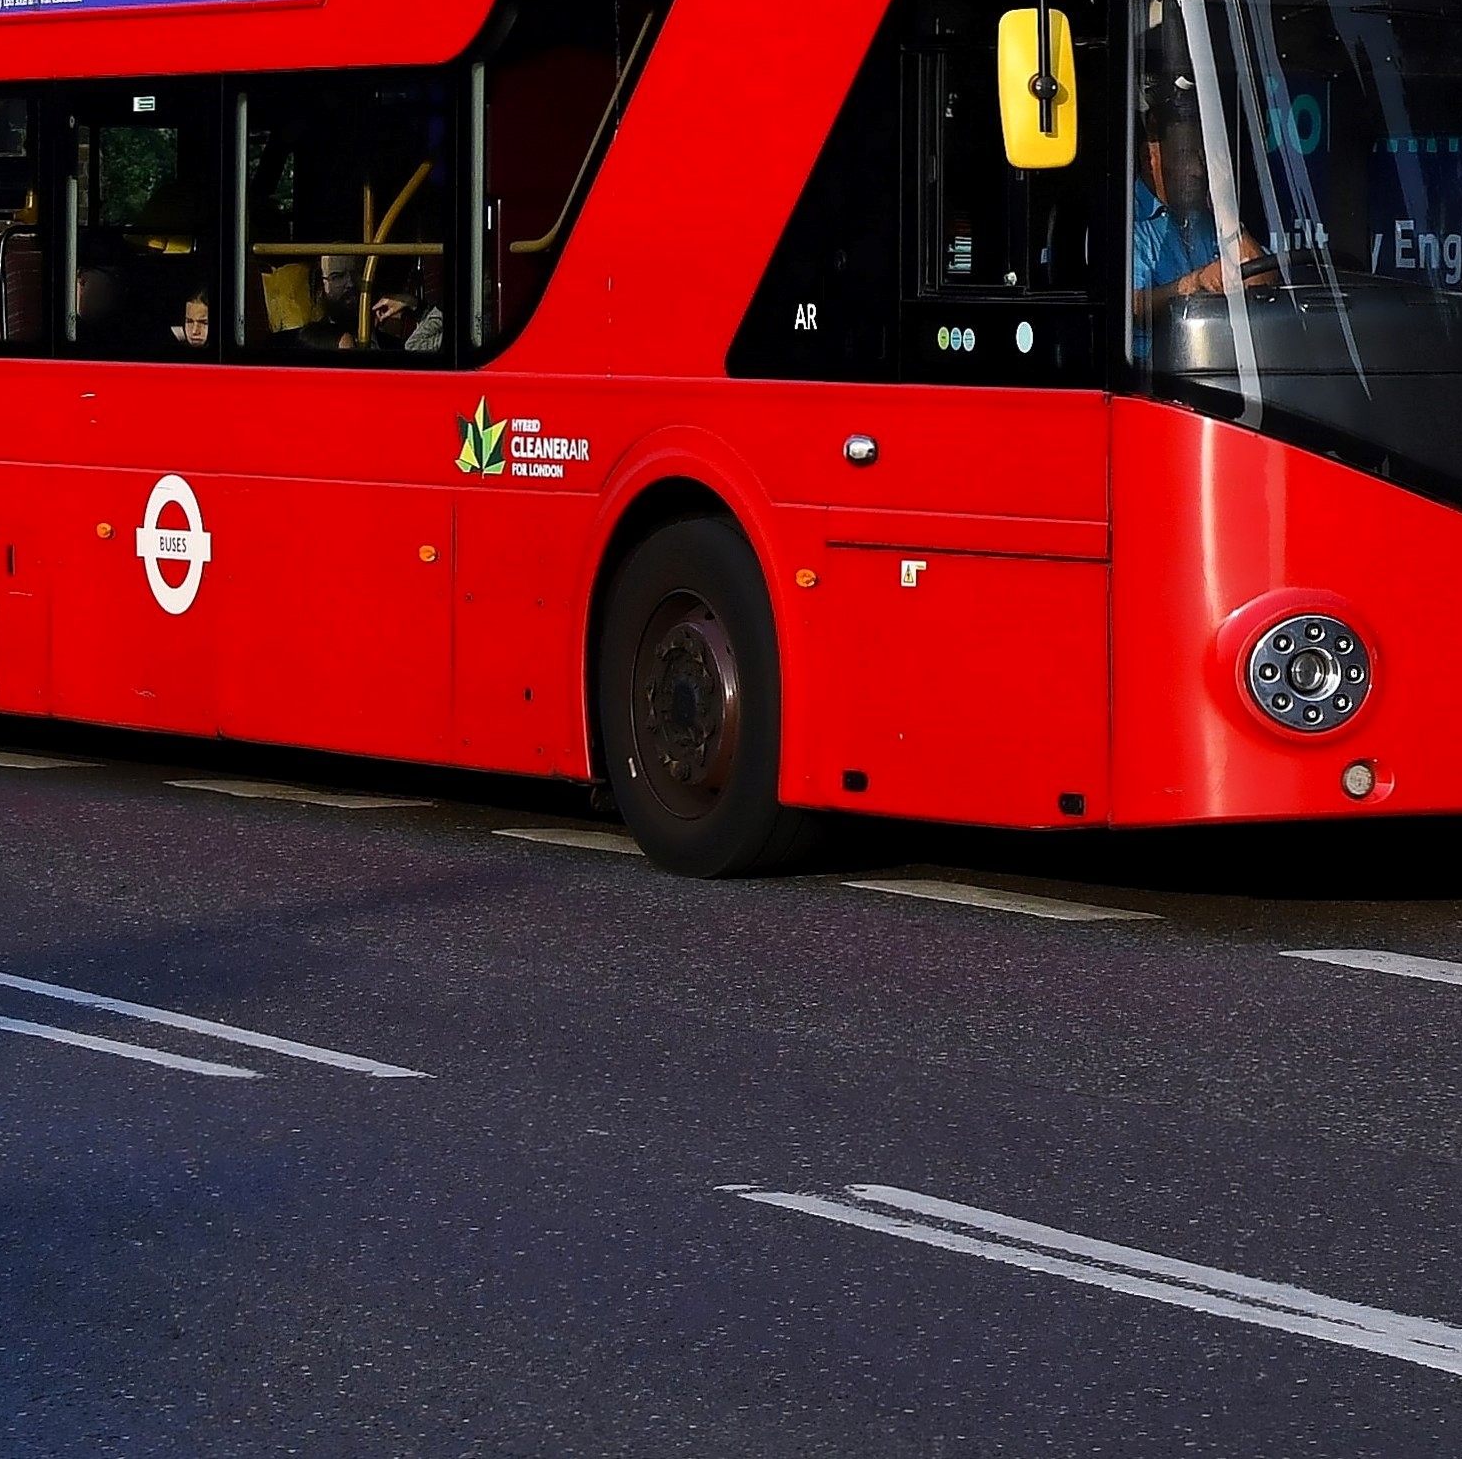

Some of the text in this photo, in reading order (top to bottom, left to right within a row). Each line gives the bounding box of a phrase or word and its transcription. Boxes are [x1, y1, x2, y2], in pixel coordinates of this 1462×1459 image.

[794, 303, 818, 330] AR
[511, 418, 541, 433] HYBRID
[511, 462, 563, 478] FOR LONDON
[159, 536, 187, 553] BUSES
